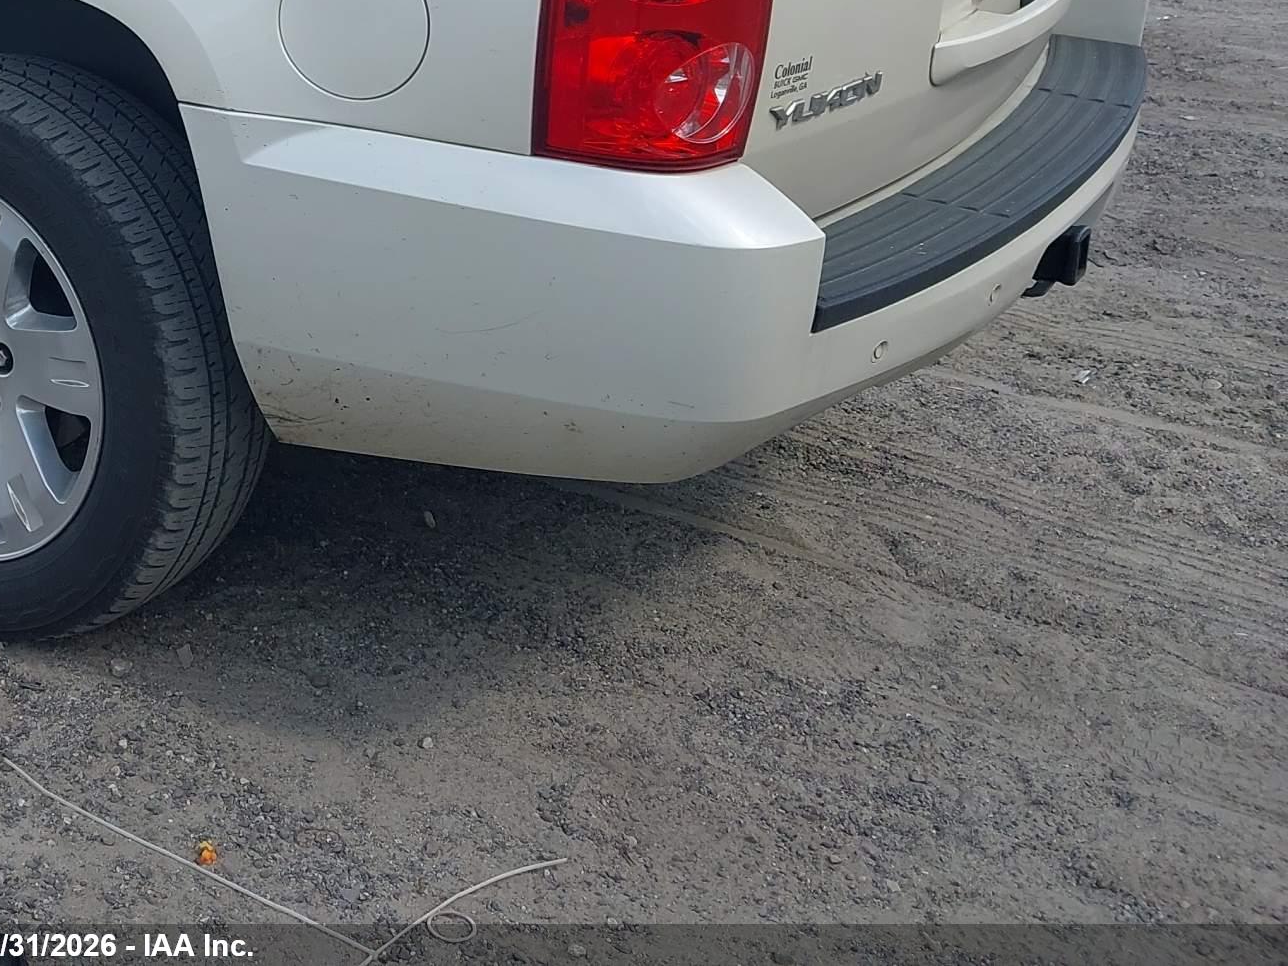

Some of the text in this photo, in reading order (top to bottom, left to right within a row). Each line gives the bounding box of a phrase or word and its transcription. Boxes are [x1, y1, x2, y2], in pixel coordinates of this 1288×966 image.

[775, 56, 813, 79] Colonial
[774, 77, 792, 89] BUICK
[770, 70, 882, 131] YUKON
